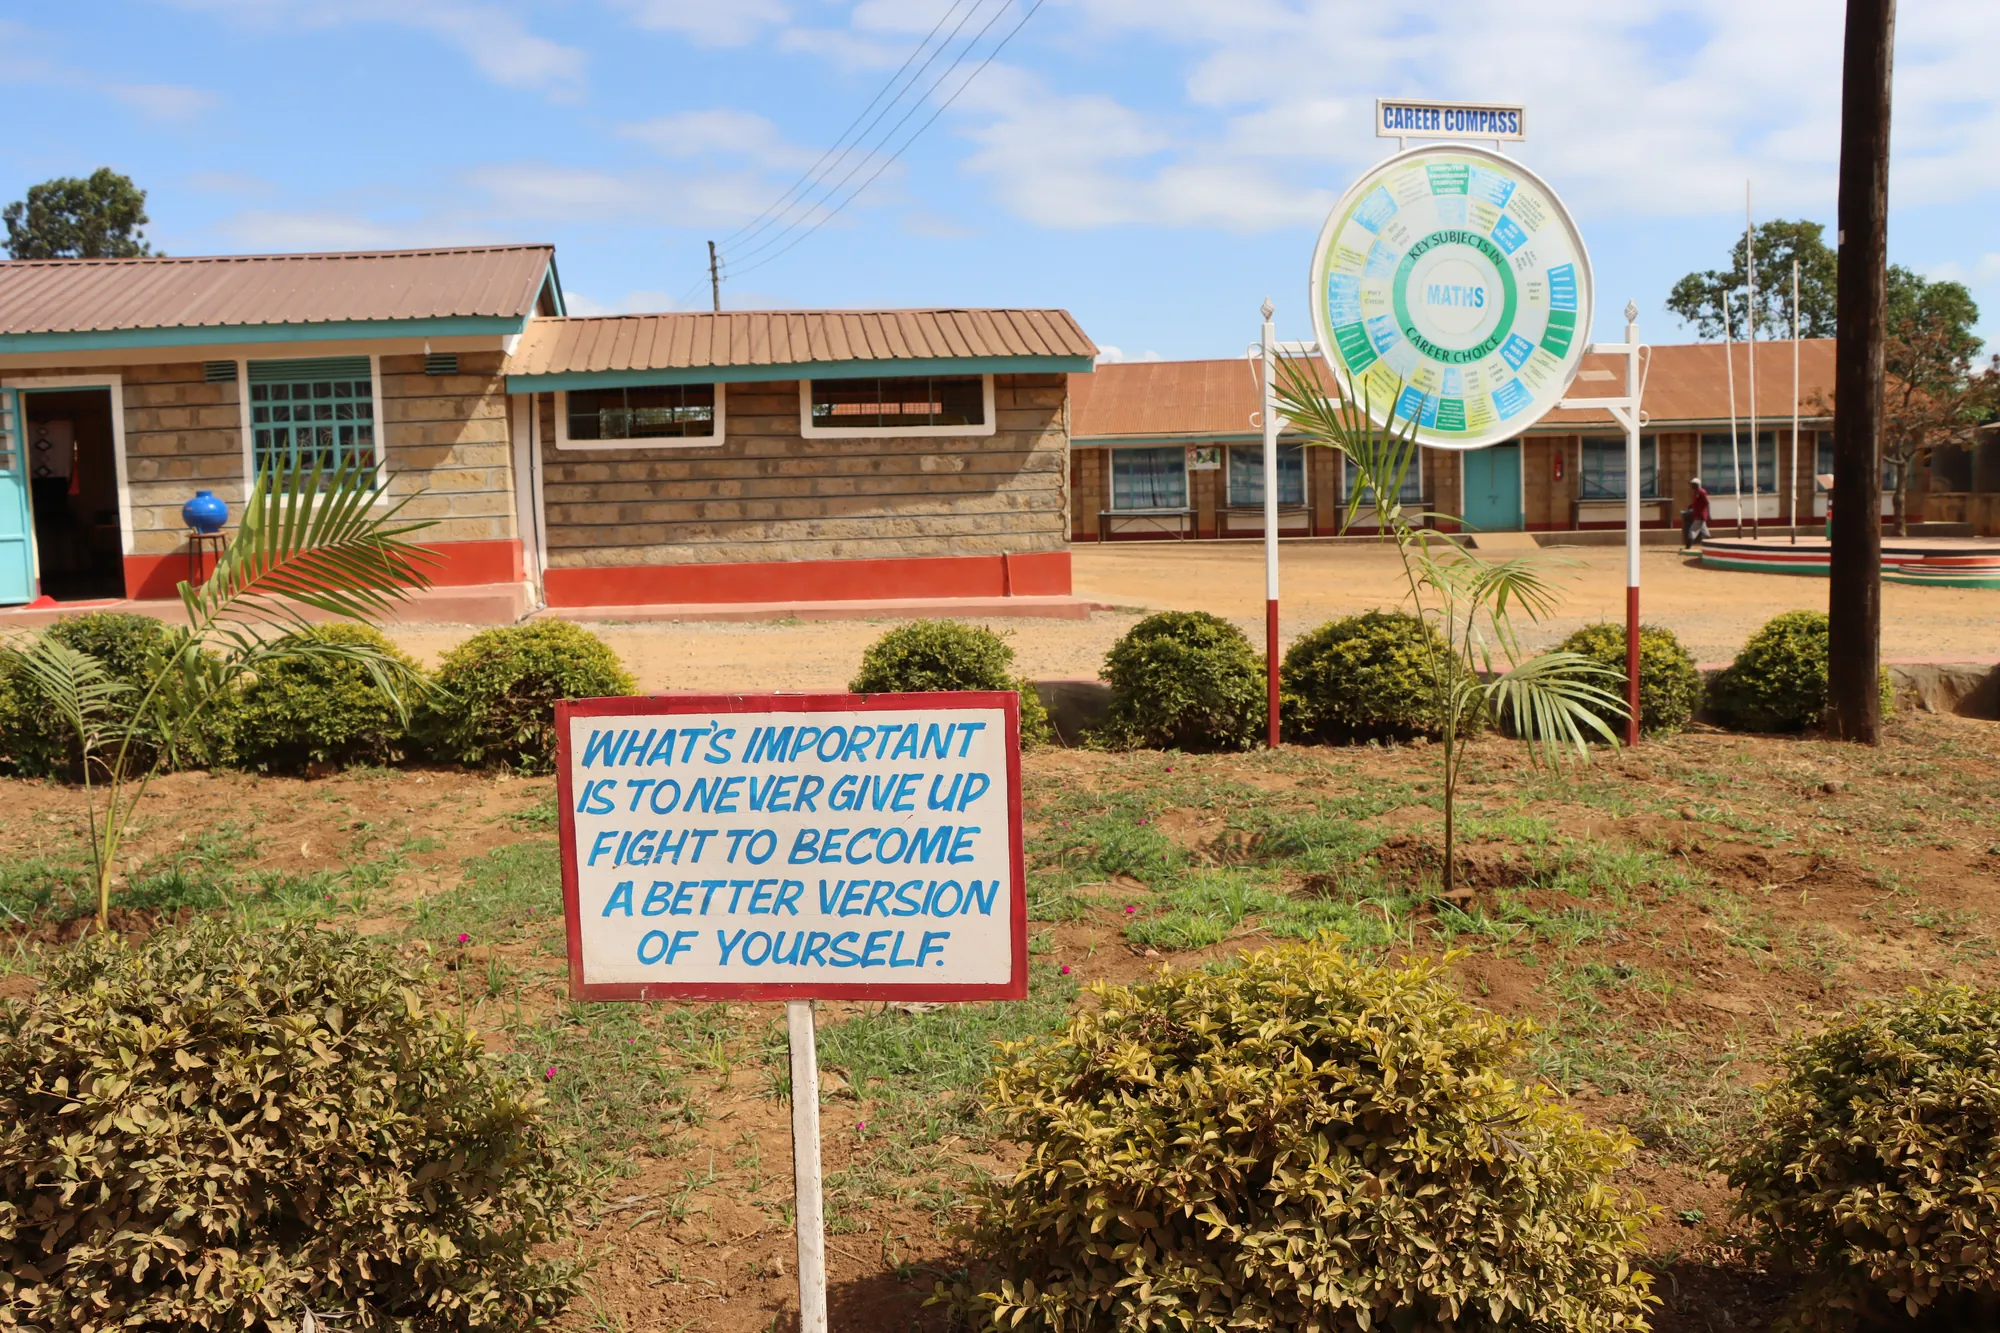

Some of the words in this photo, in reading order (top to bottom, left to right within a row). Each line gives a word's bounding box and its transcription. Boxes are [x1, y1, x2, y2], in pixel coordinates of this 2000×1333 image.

[1383, 106, 1440, 131] CAREER
[1444, 108, 1518, 134] COMPASS
[1408, 239, 1431, 261] KEY
[1431, 230, 1491, 254] SUBJECTS
[1488, 249, 1504, 266] IN
[1427, 284, 1485, 308] MATHS
[1406, 326, 1450, 362] CAREER
[1453, 334, 1501, 363] CHOICE
[581, 719, 736, 767] WHAT'S
[741, 722, 986, 763] IMPORTANT
[577, 779, 618, 814] IS
[626, 778, 681, 815] TO
[683, 775, 825, 814] NEVER
[828, 773, 925, 812] GIVE
[926, 772, 991, 812] UP
[587, 829, 719, 866] FIGHT
[726, 829, 778, 865] TO
[788, 826, 982, 865] BECOME
[602, 881, 634, 917] A
[641, 879, 804, 917] BETTER
[819, 880, 1000, 918] VERSION
[636, 930, 699, 965] OF
[717, 929, 951, 968] YOURSELF.
